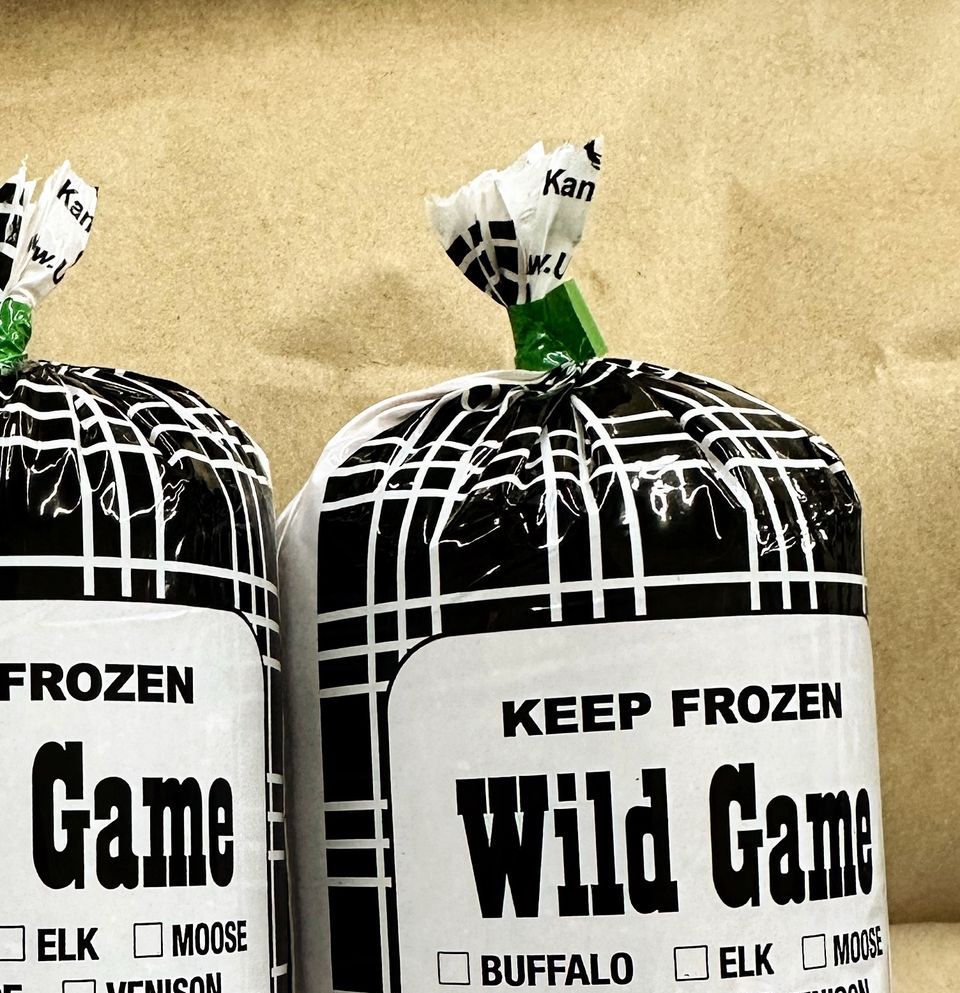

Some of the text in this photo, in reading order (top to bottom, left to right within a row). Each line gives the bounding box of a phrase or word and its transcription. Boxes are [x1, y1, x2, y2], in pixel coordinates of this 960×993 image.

[56, 179, 94, 232] Kan
[543, 168, 595, 202] Kan
[502, 683, 842, 737] KEEP FROZEN
[32, 742, 233, 889] Game
[456, 763, 872, 918] Wild Game
[38, 928, 99, 961] ELK
[173, 921, 247, 956] MOOSE
[481, 926, 883, 986] BUFFALO ELK MOOSE
